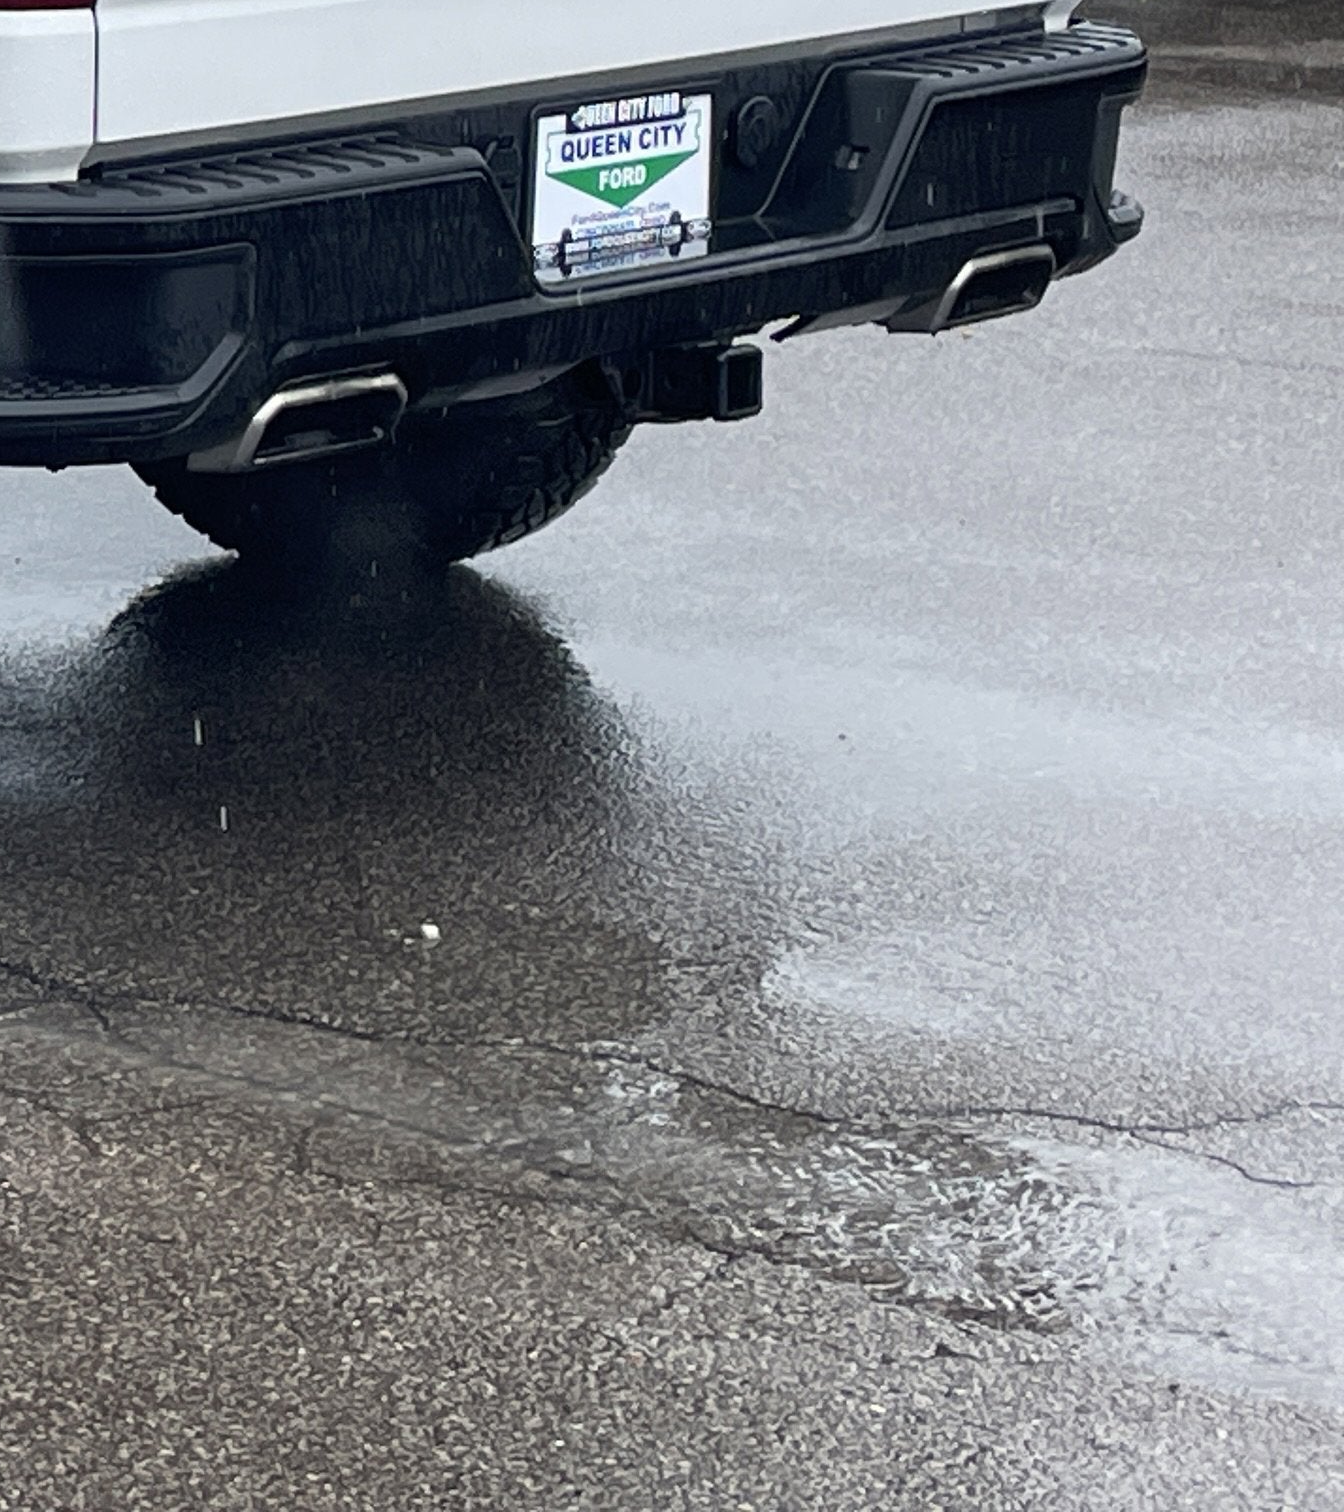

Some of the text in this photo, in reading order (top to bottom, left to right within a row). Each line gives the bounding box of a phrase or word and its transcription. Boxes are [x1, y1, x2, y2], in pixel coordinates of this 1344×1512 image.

[561, 122, 688, 163] QUEEN CITY
[598, 163, 647, 191] FORD
